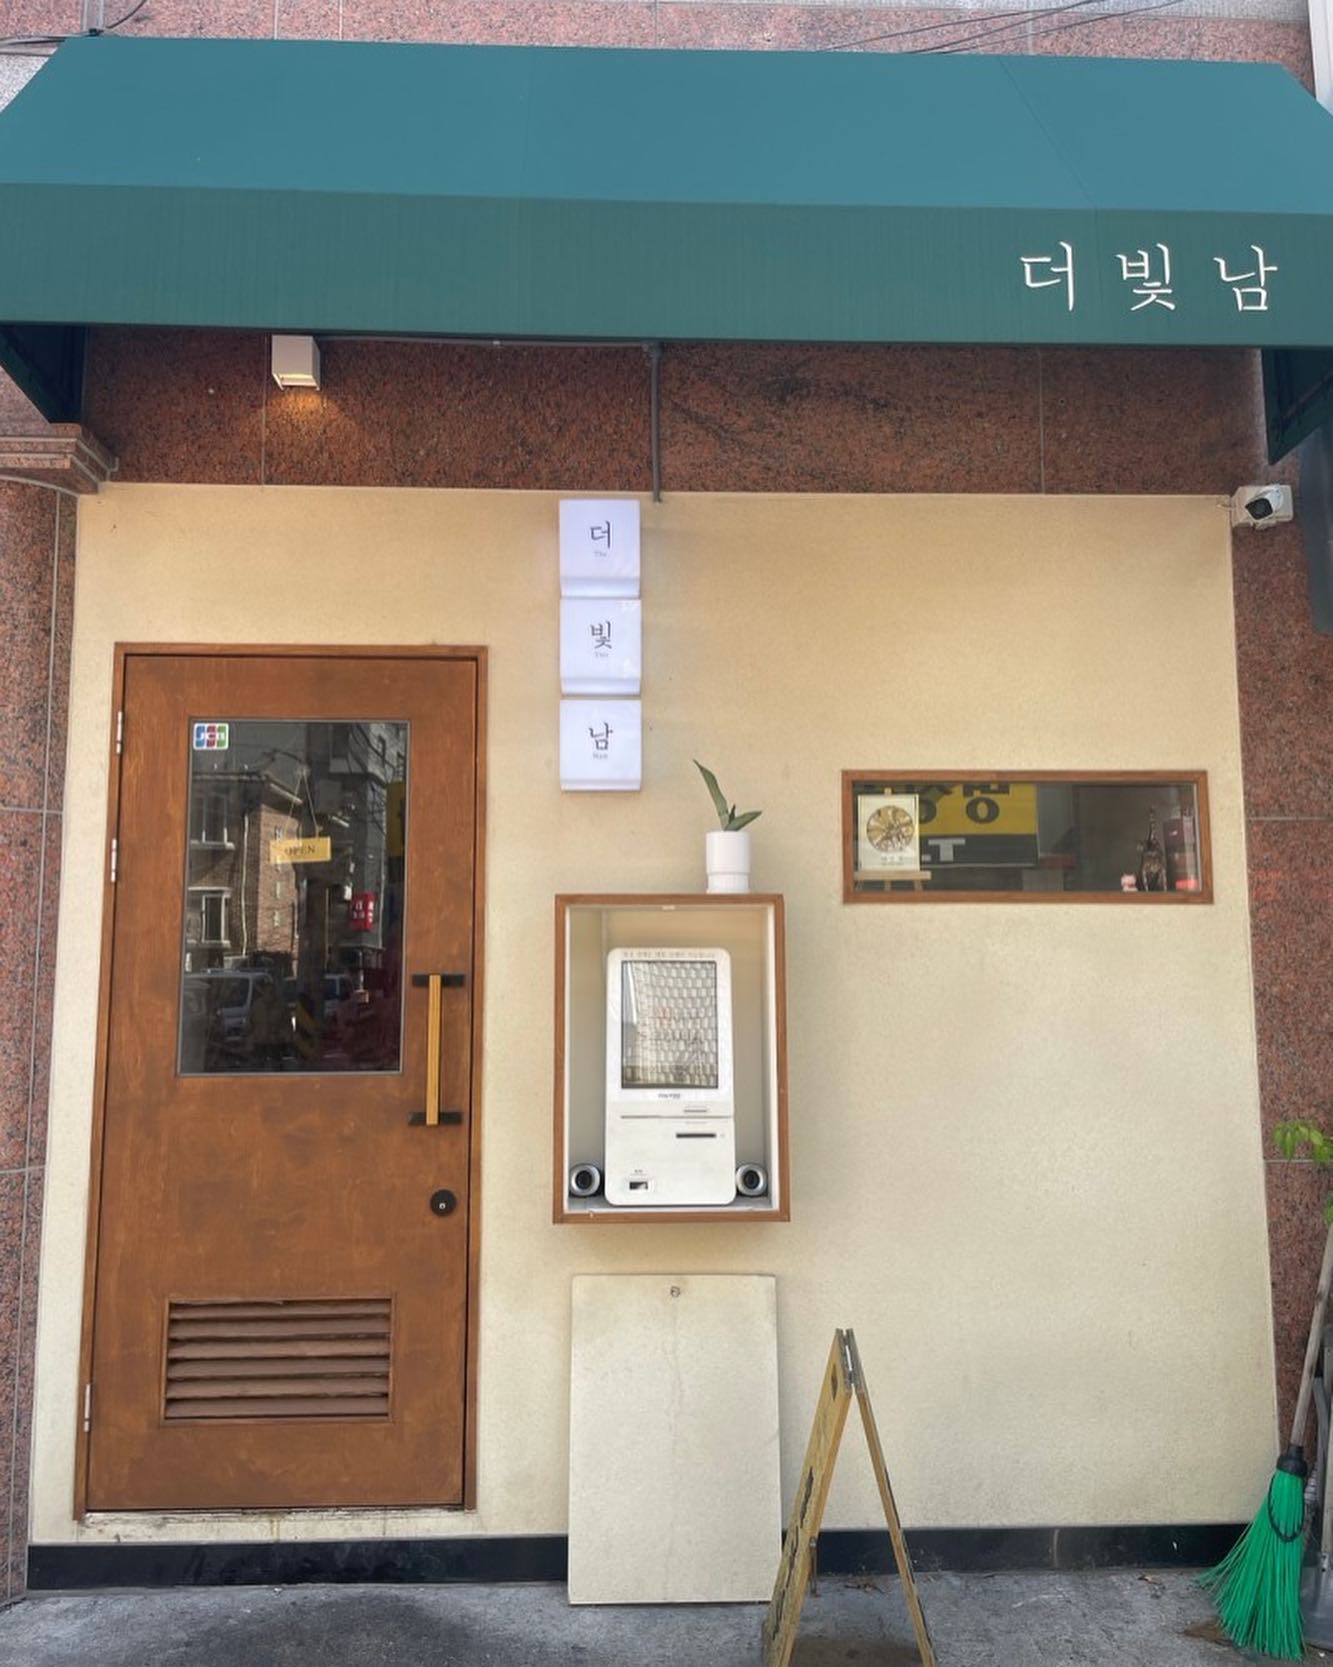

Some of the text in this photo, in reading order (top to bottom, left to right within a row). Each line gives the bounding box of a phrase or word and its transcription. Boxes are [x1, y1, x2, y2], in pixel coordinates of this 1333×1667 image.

[1020, 241, 1278, 312] 더 빛 남
[589, 520, 611, 549] 더
[590, 620, 613, 650] 빛
[588, 722, 613, 751] 남
[283, 844, 316, 857] OPEN
